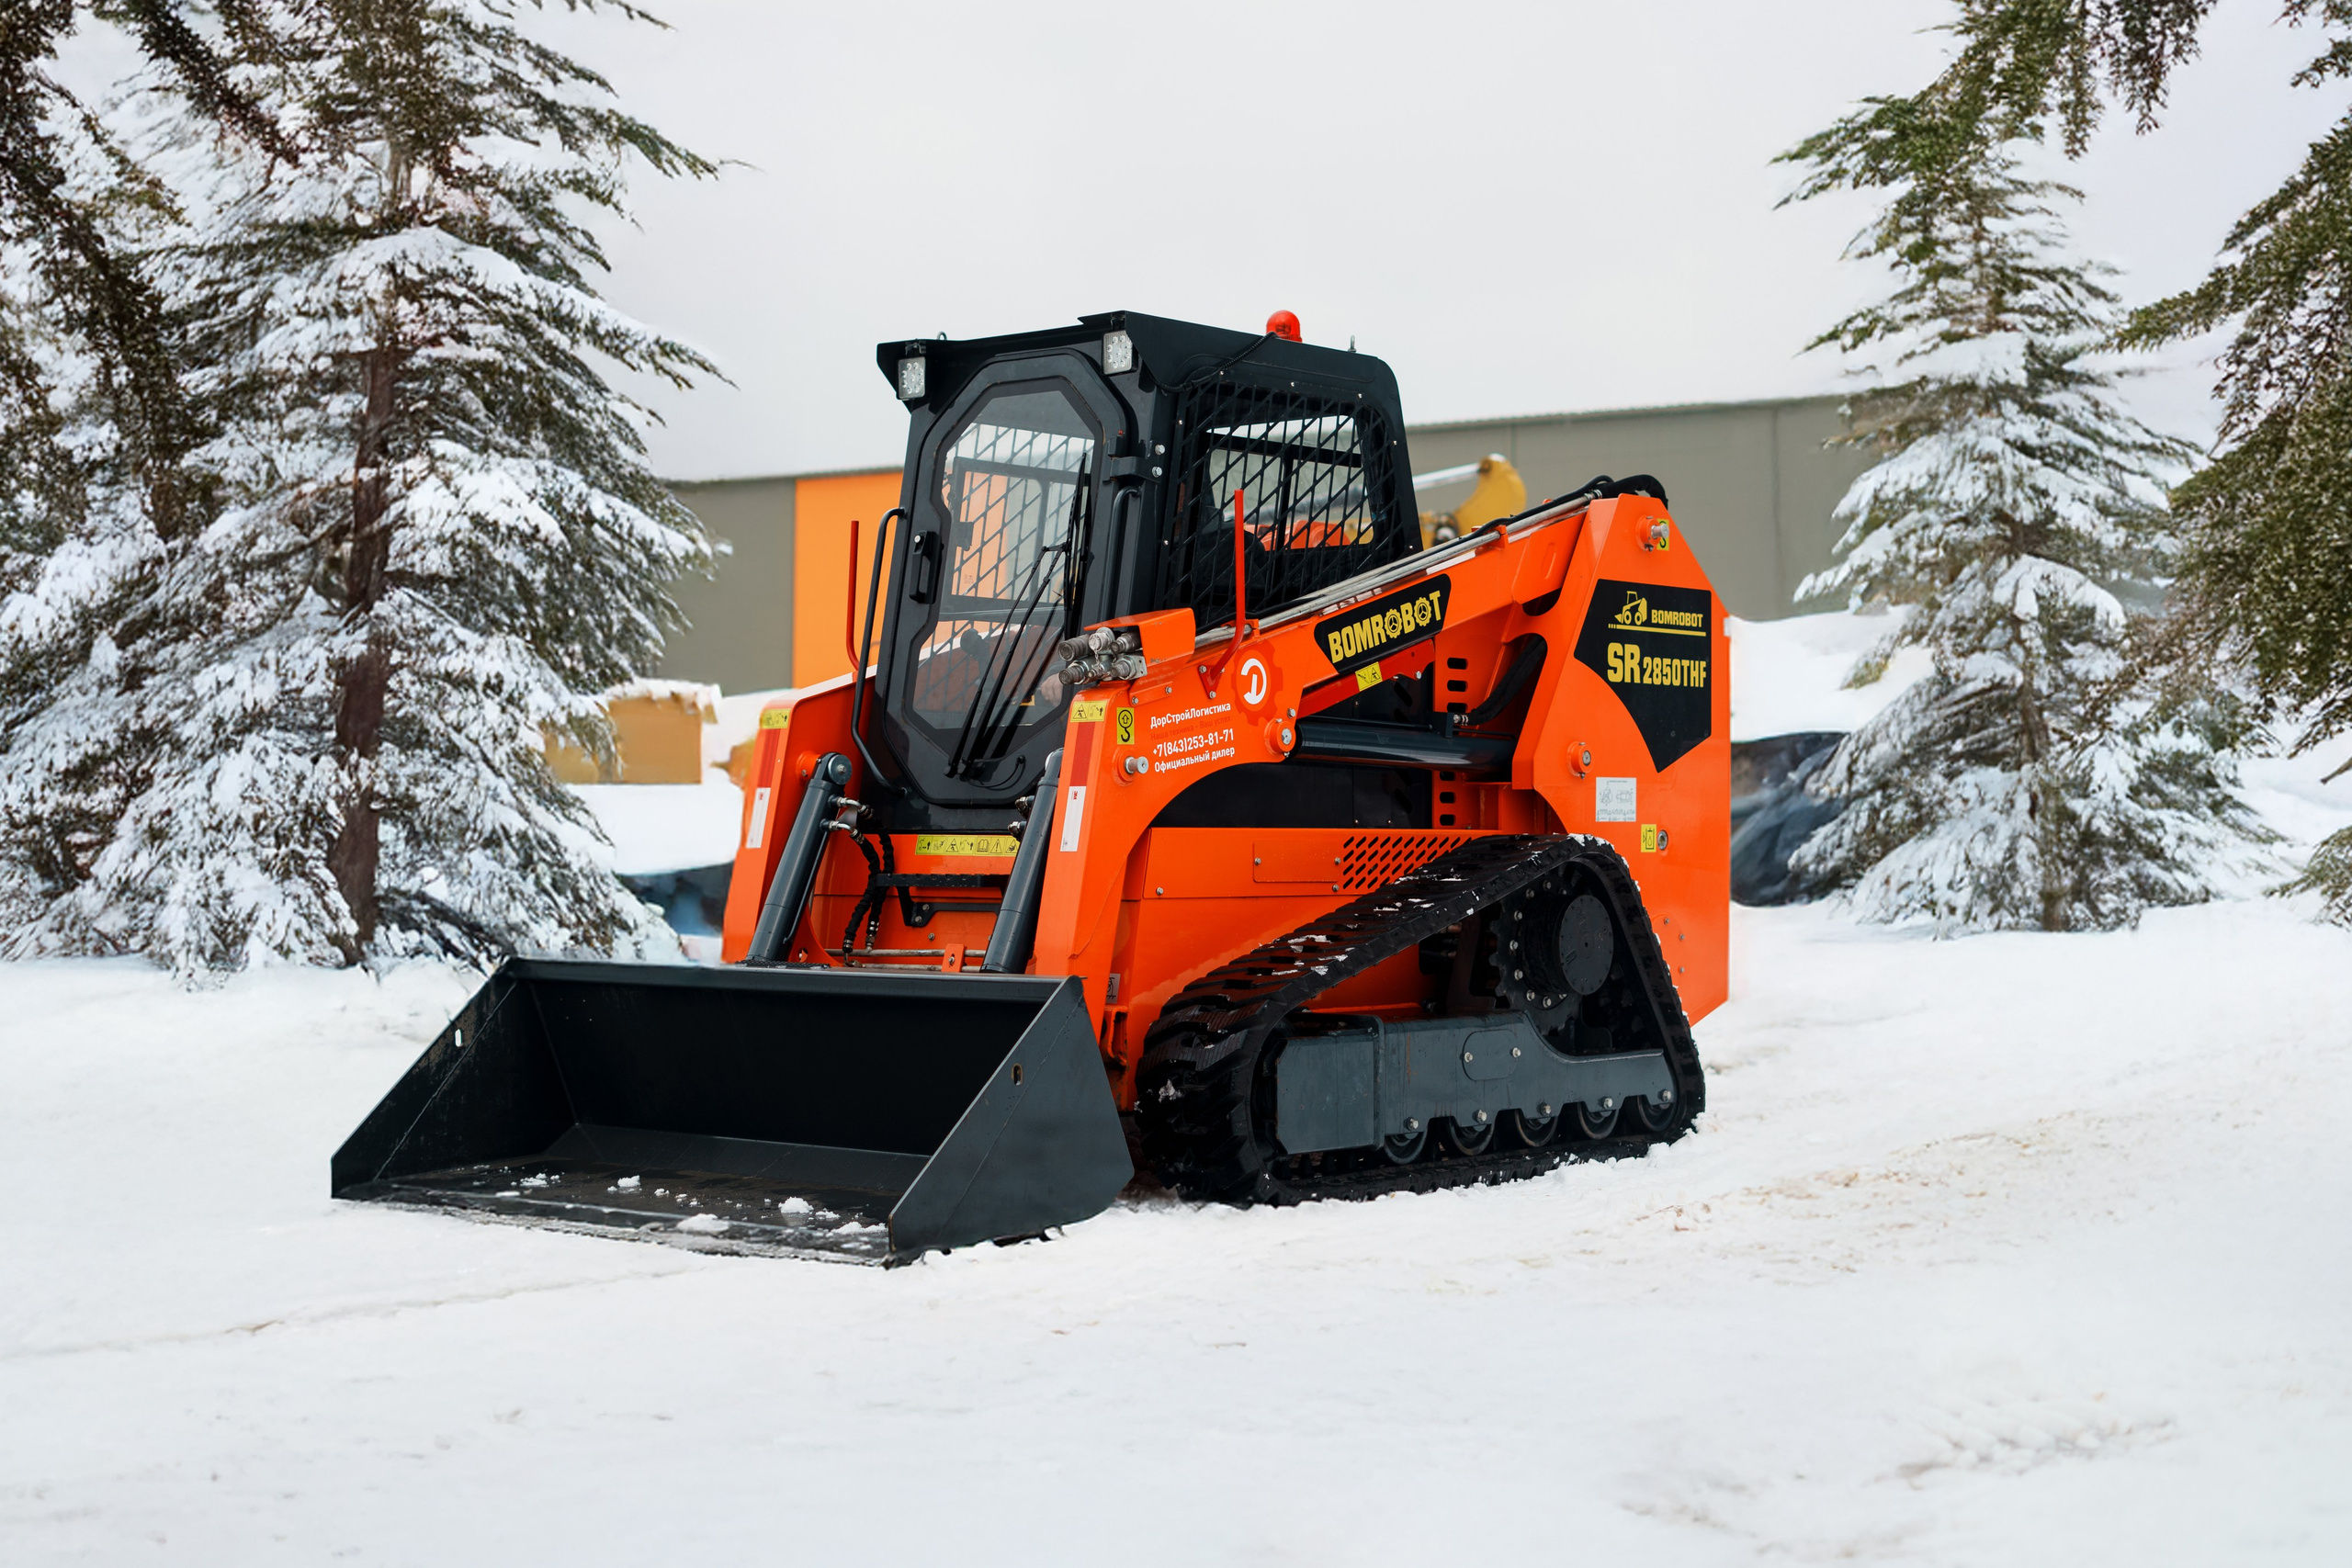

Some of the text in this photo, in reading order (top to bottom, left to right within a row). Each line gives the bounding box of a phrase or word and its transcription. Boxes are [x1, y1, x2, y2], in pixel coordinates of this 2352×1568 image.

[1328, 590, 1442, 664] BOMROBOT
[1651, 609, 1703, 627] BOMROBOT
[1607, 642, 1707, 688] SR 2850THF
[1150, 703, 1231, 729] ДорСтройЛогистика
[1153, 728, 1234, 757] +7(843)253-81-71
[1154, 747, 1235, 773] Официальный дилер
